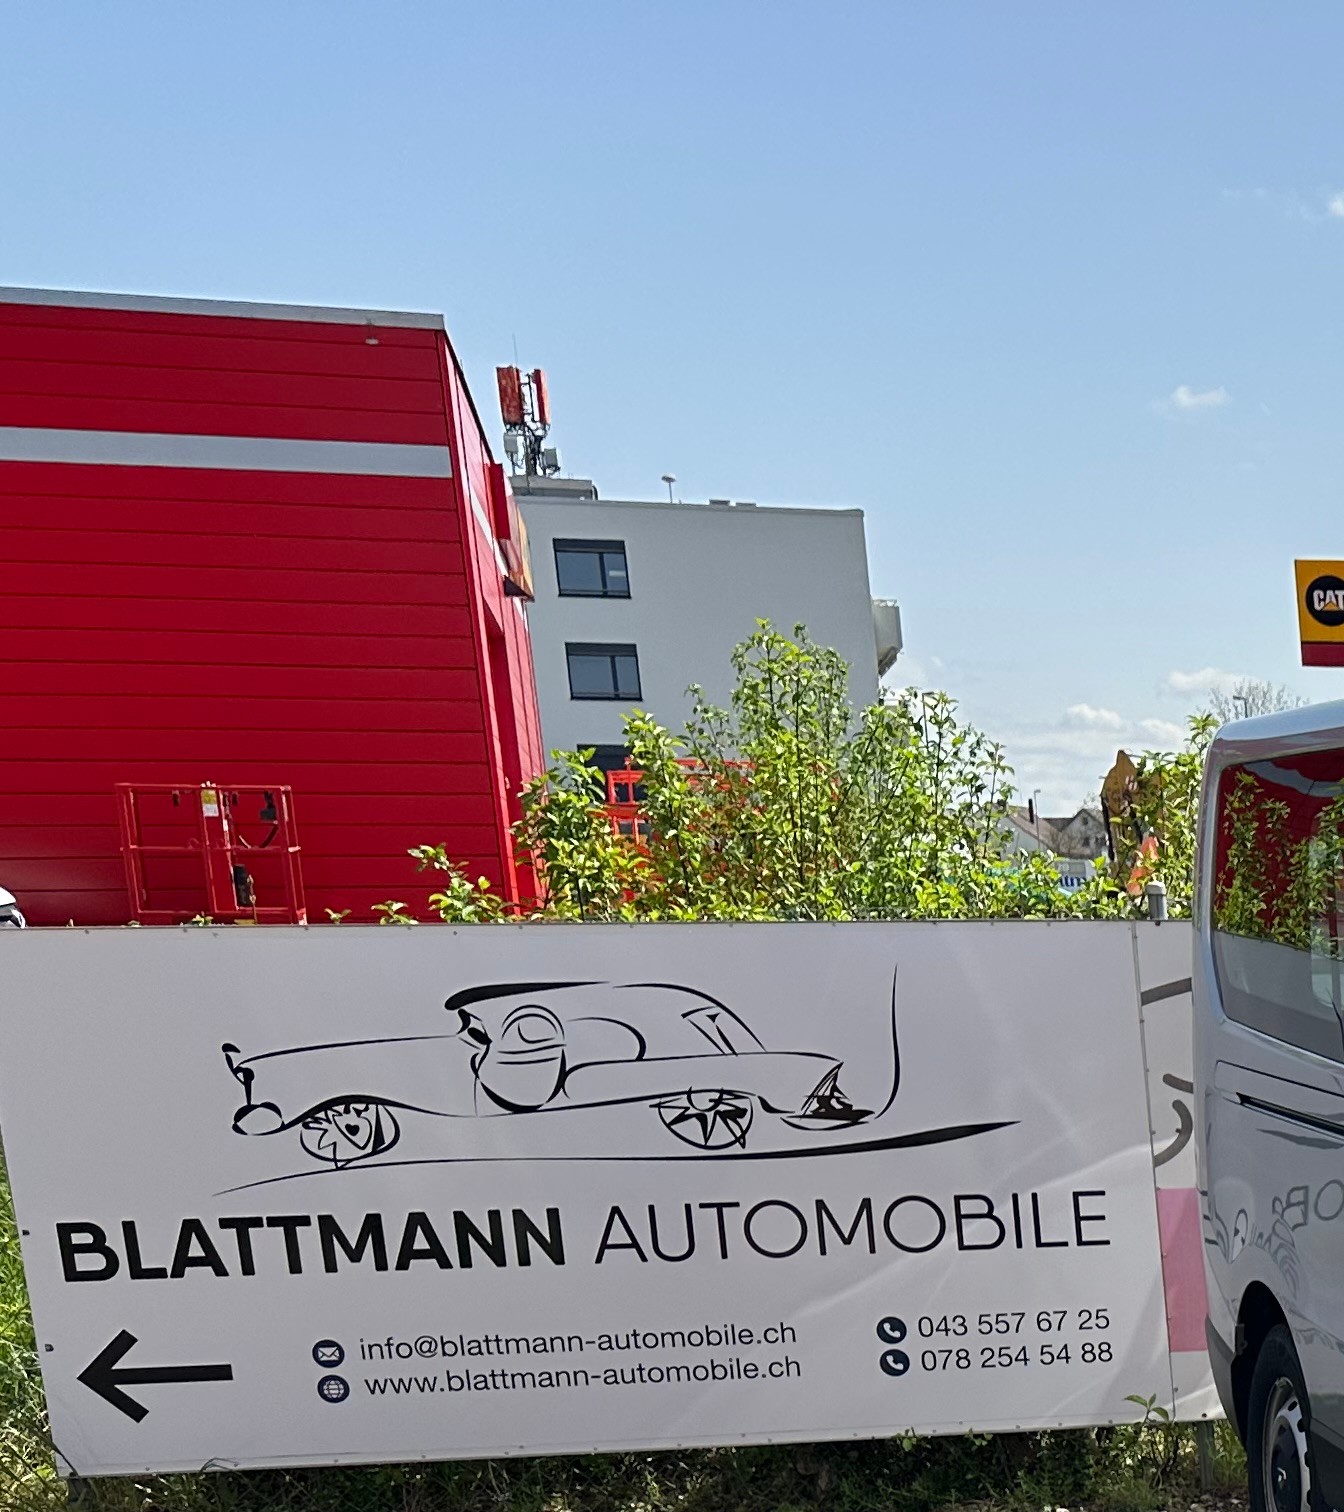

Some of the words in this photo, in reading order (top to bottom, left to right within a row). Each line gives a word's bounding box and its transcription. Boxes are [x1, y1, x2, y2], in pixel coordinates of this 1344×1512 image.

[56, 1207, 565, 1283] BLATTMANN
[594, 1190, 1112, 1264] AUTOMOBILE
[359, 1320, 797, 1362] info@blattmann-automobile.ch
[918, 1314, 969, 1339] 043
[977, 1312, 1026, 1337] 557
[1035, 1310, 1069, 1334] 67
[1077, 1308, 1111, 1331] 25
[364, 1355, 802, 1396] www.blattmann-automobile.ch
[920, 1348, 973, 1373] 078
[979, 1345, 1031, 1370] 254
[1039, 1343, 1073, 1368] 54
[1080, 1341, 1114, 1365] 88
